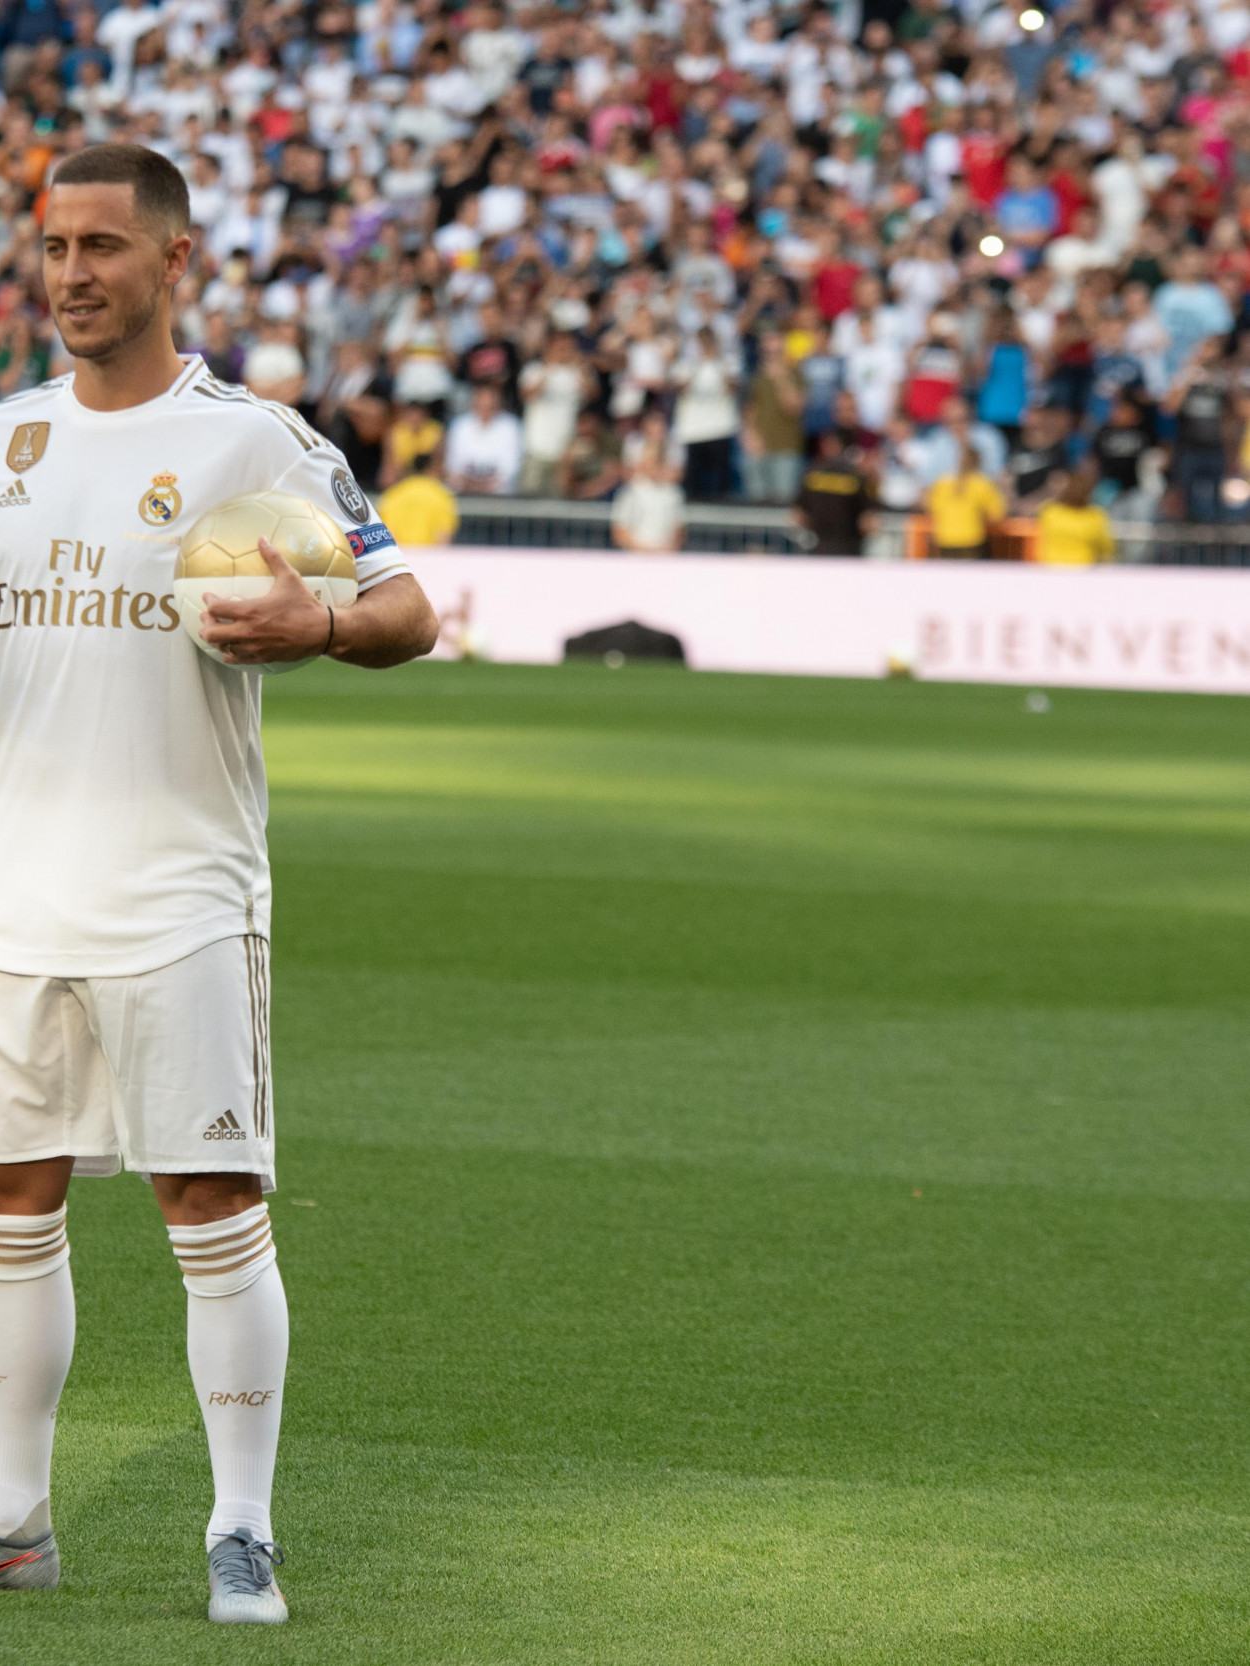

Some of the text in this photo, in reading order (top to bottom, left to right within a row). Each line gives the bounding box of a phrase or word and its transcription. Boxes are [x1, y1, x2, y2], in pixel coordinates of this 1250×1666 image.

[361, 529, 392, 546] RESPEC
[49, 539, 106, 579] Fly
[203, 1128, 247, 1141] adidas
[208, 1390, 275, 1406] RMCF
